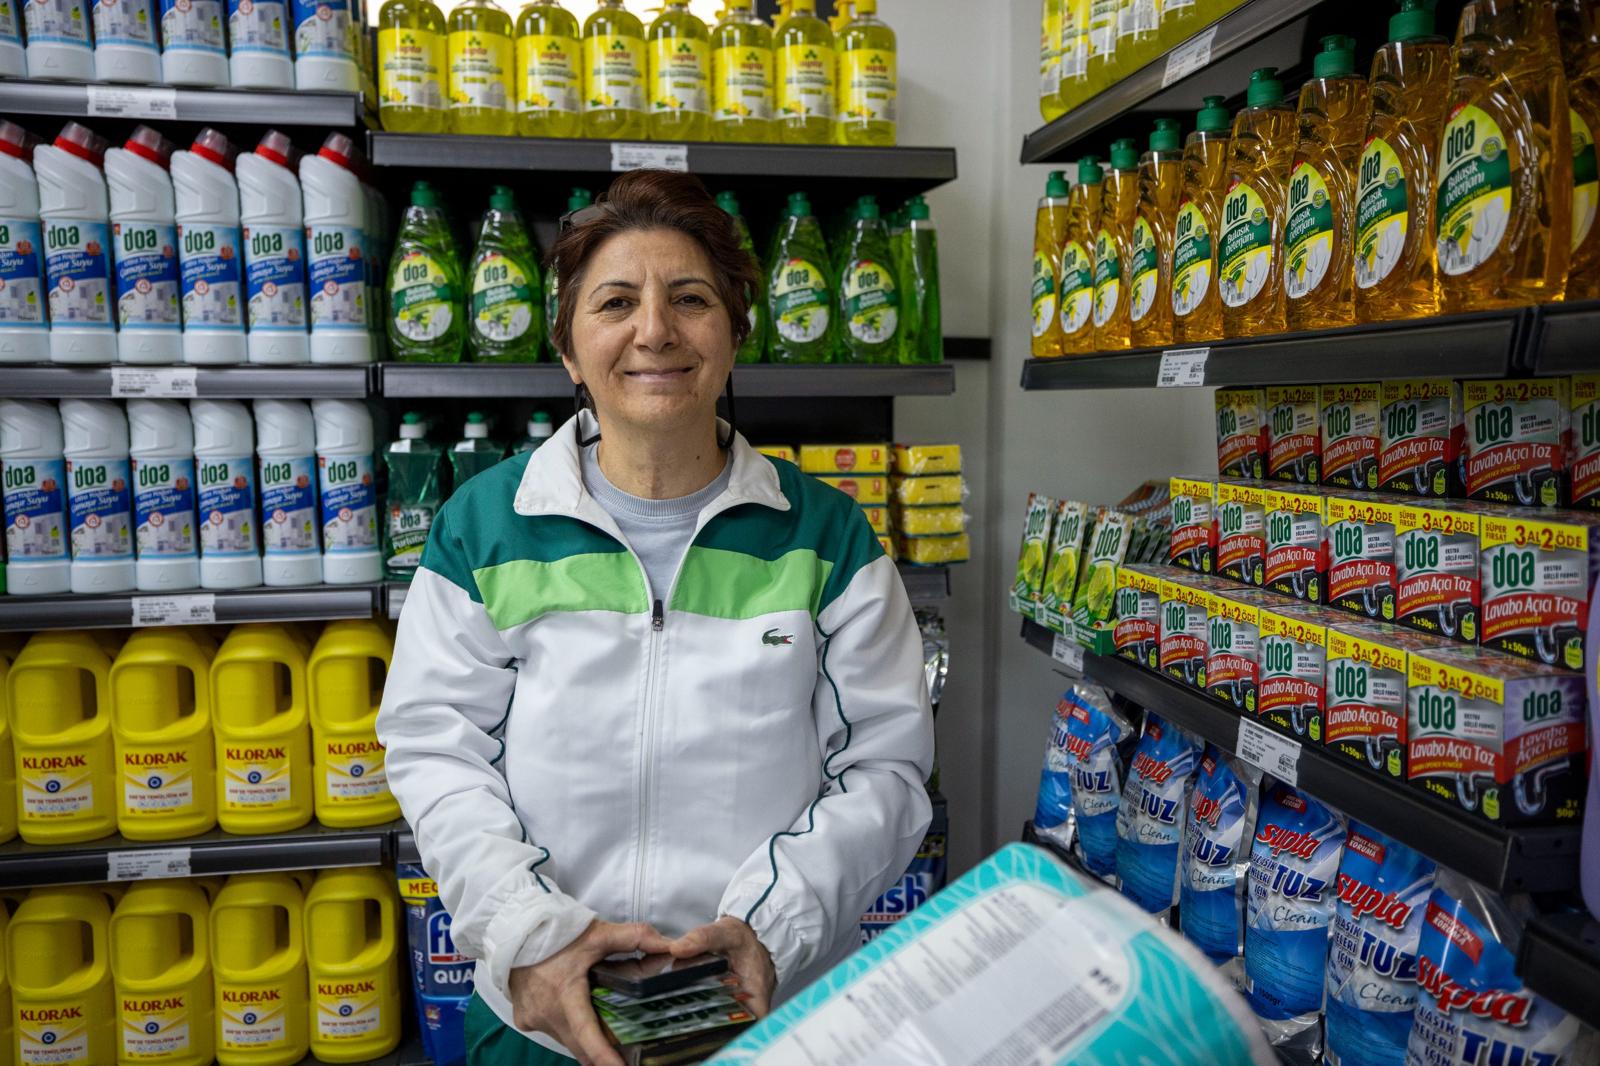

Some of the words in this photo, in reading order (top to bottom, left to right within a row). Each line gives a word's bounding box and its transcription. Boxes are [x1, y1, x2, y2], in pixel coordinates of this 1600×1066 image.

[1447, 119, 1475, 164] doa
[1361, 151, 1381, 190] doa
[1447, 160, 1478, 190] Bulaşık
[1290, 174, 1309, 209] doa
[1445, 172, 1485, 204] Deterjanı
[1226, 193, 1247, 225] doa
[48, 225, 80, 249] doa
[1177, 211, 1192, 239] doa
[1227, 224, 1250, 244] Bulaşık
[124, 227, 157, 251] doa
[185, 230, 215, 253] doa
[252, 231, 283, 255] doa
[314, 231, 344, 254] doa
[1225, 232, 1255, 256] Deterjanı
[403, 264, 427, 282] doa
[484, 264, 508, 283] doa
[787, 269, 809, 287] doa
[858, 271, 880, 289] doa
[1220, 407, 1236, 436] doa
[1273, 405, 1294, 436] doa
[1327, 404, 1350, 439] doa
[1388, 403, 1417, 440] doa
[1475, 405, 1513, 445] doa
[1469, 451, 1503, 476] Lavabo
[1504, 447, 1529, 465] Açıcı
[1531, 443, 1551, 458] Toz
[5, 465, 36, 489] doa
[74, 465, 107, 488] doa
[139, 464, 170, 487] doa
[201, 462, 229, 485] doa
[264, 462, 292, 484] doa
[328, 460, 358, 484] doa
[400, 511, 421, 529] doa
[1027, 506, 1046, 536] doa
[1174, 498, 1191, 525] doa
[1223, 503, 1242, 533] doa
[1348, 505, 1356, 522] 3
[1357, 509, 1366, 518] AL
[1365, 507, 1374, 524] 2
[1375, 509, 1393, 522] ÖDE
[1422, 513, 1431, 531] 3
[1432, 518, 1443, 528] AL
[1443, 515, 1453, 533] 2
[1454, 518, 1475, 532] ÖDE
[1058, 514, 1080, 547] doa
[1270, 512, 1291, 545] doa
[1335, 523, 1362, 557] doa
[1514, 525, 1525, 546] 3
[1527, 531, 1541, 542] AL
[1541, 528, 1554, 549] 2
[1555, 530, 1582, 548] ÖDE
[1094, 523, 1123, 559] doa
[1405, 532, 1438, 570] doa
[1330, 565, 1355, 585] Lavabo
[1356, 563, 1374, 580] Açıcı
[1375, 562, 1391, 577] Toz
[1493, 547, 1535, 588] doa
[1399, 580, 1429, 600] Lavabo
[1430, 576, 1452, 594] Açıcı
[1453, 576, 1472, 592] Toz
[1120, 590, 1138, 615] doa
[1485, 600, 1523, 621] Lavabo
[1524, 597, 1552, 616] Açıcı
[1554, 596, 1578, 615] Toz
[1165, 602, 1185, 631] doa
[1211, 619, 1231, 649] doa
[1280, 621, 1287, 637] 3
[1288, 627, 1297, 636] AL
[1296, 625, 1304, 643] 2
[1305, 628, 1322, 644] ÖDE
[1266, 637, 1293, 671] doa
[1352, 642, 1361, 661] 3
[1361, 649, 1372, 660] AL
[1371, 648, 1381, 668] 2
[1382, 653, 1402, 670] ÖDE
[1260, 680, 1285, 697] Lavabo
[1285, 681, 1303, 697] Açıcı
[1303, 682, 1318, 698] Toz
[1335, 660, 1367, 698] doa
[1438, 669, 1448, 689] 3
[1449, 677, 1461, 689] AL
[1461, 676, 1473, 697] 2
[1475, 681, 1499, 699] ÖDE
[1328, 708, 1357, 725] Lavabo
[1358, 708, 1379, 726] Açıcı
[1381, 712, 1398, 728] Toz
[1418, 688, 1456, 731] doa
[1523, 690, 1562, 722] doa
[1519, 726, 1567, 749] Lavabo
[22, 755, 87, 770] KLORAK
[125, 751, 187, 766] KLORAK
[226, 746, 286, 761] KLORAK
[1411, 742, 1446, 759] Lavabo
[1447, 742, 1472, 761] Açıcı
[1474, 744, 1496, 766] Toz
[1516, 741, 1546, 766] Açıcı
[1548, 735, 1568, 749] Toz
[1076, 767, 1110, 792] TUZ
[1139, 788, 1178, 824] TUZ
[1139, 823, 1173, 841] Clean
[1349, 839, 1377, 858] KORUMA
[1191, 869, 1228, 885] Clean
[1271, 863, 1328, 902] TUZ
[1273, 905, 1321, 925] Clean
[1359, 931, 1418, 981] TUZ
[222, 989, 281, 1003] KLORAK
[317, 981, 376, 995] KLORAK
[20, 1006, 82, 1022] KLORAK
[123, 997, 184, 1012] KLORAK
[1462, 1029, 1558, 1066] TUZ
